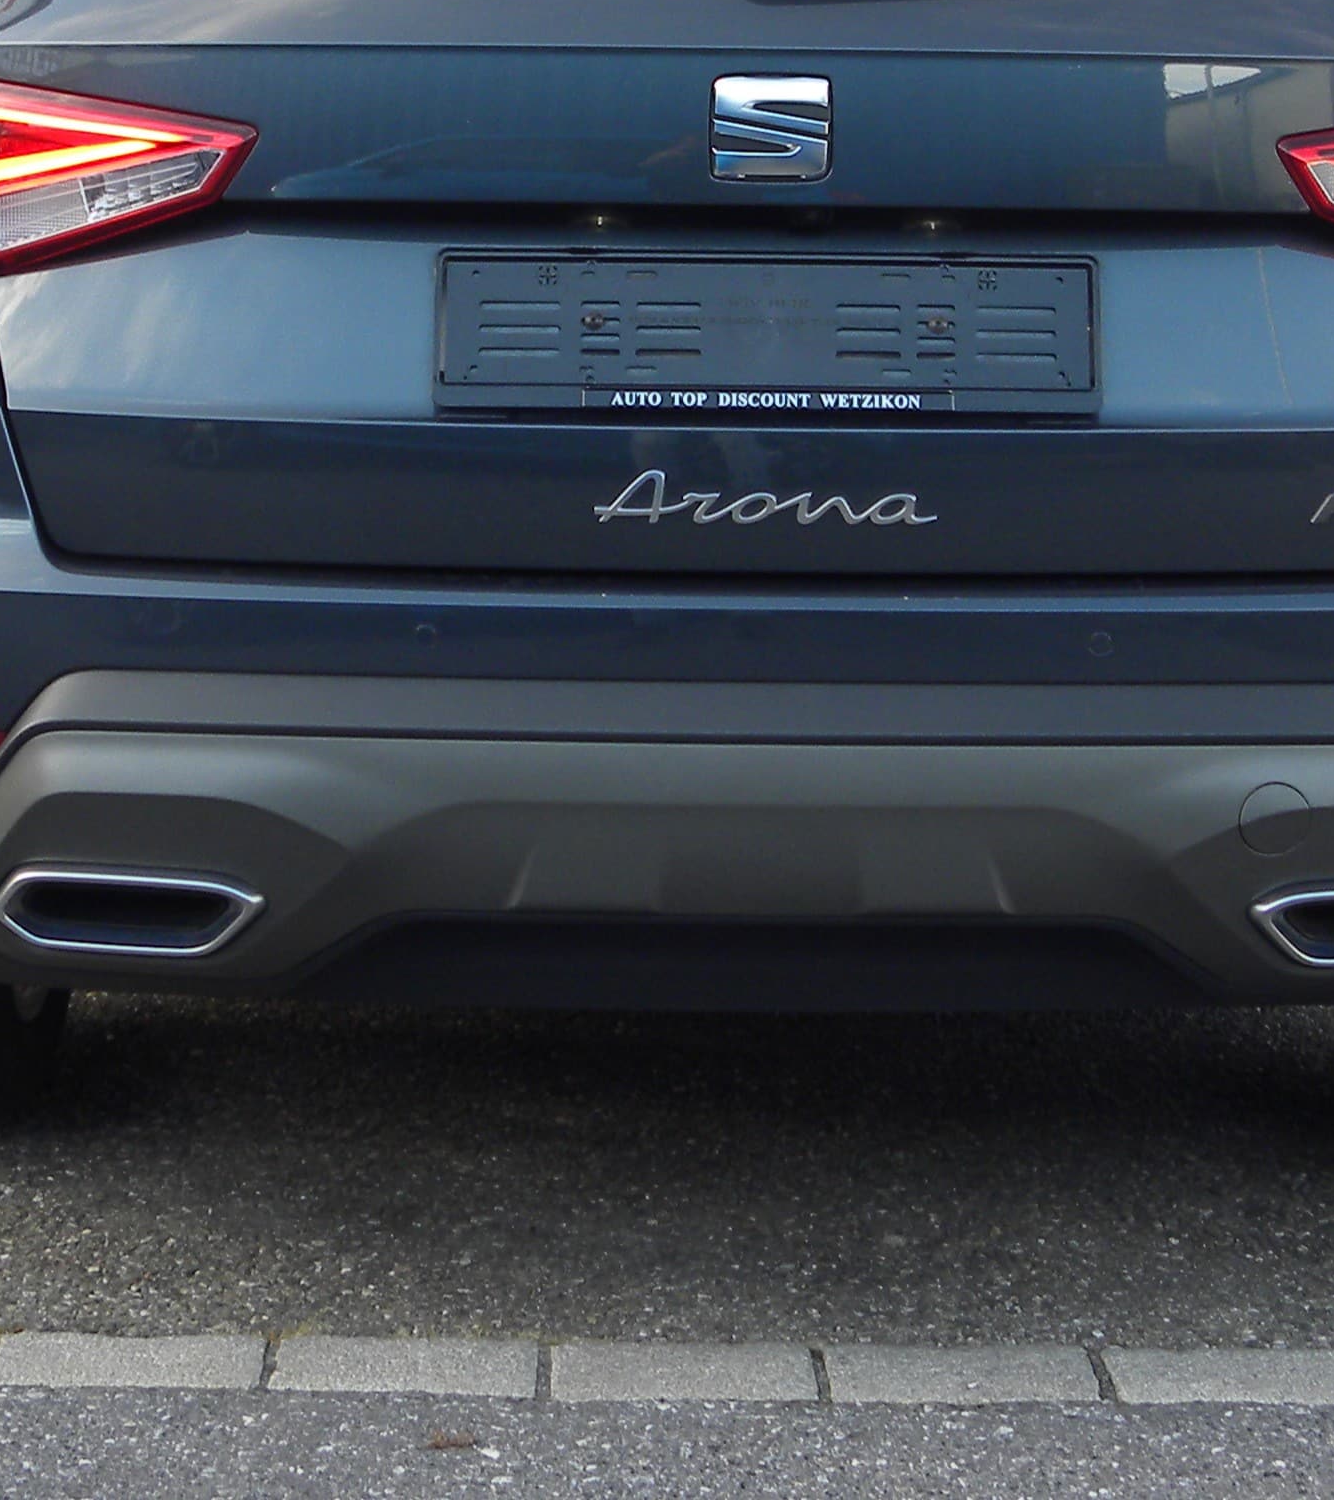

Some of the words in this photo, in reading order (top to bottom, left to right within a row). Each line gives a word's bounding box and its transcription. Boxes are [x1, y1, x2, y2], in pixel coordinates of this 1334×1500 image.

[611, 391, 662, 407] AUTO
[670, 392, 708, 407] TOP
[718, 392, 811, 408] DISCOUNT
[820, 393, 921, 409] WETZIKON
[593, 469, 938, 525] Arona
